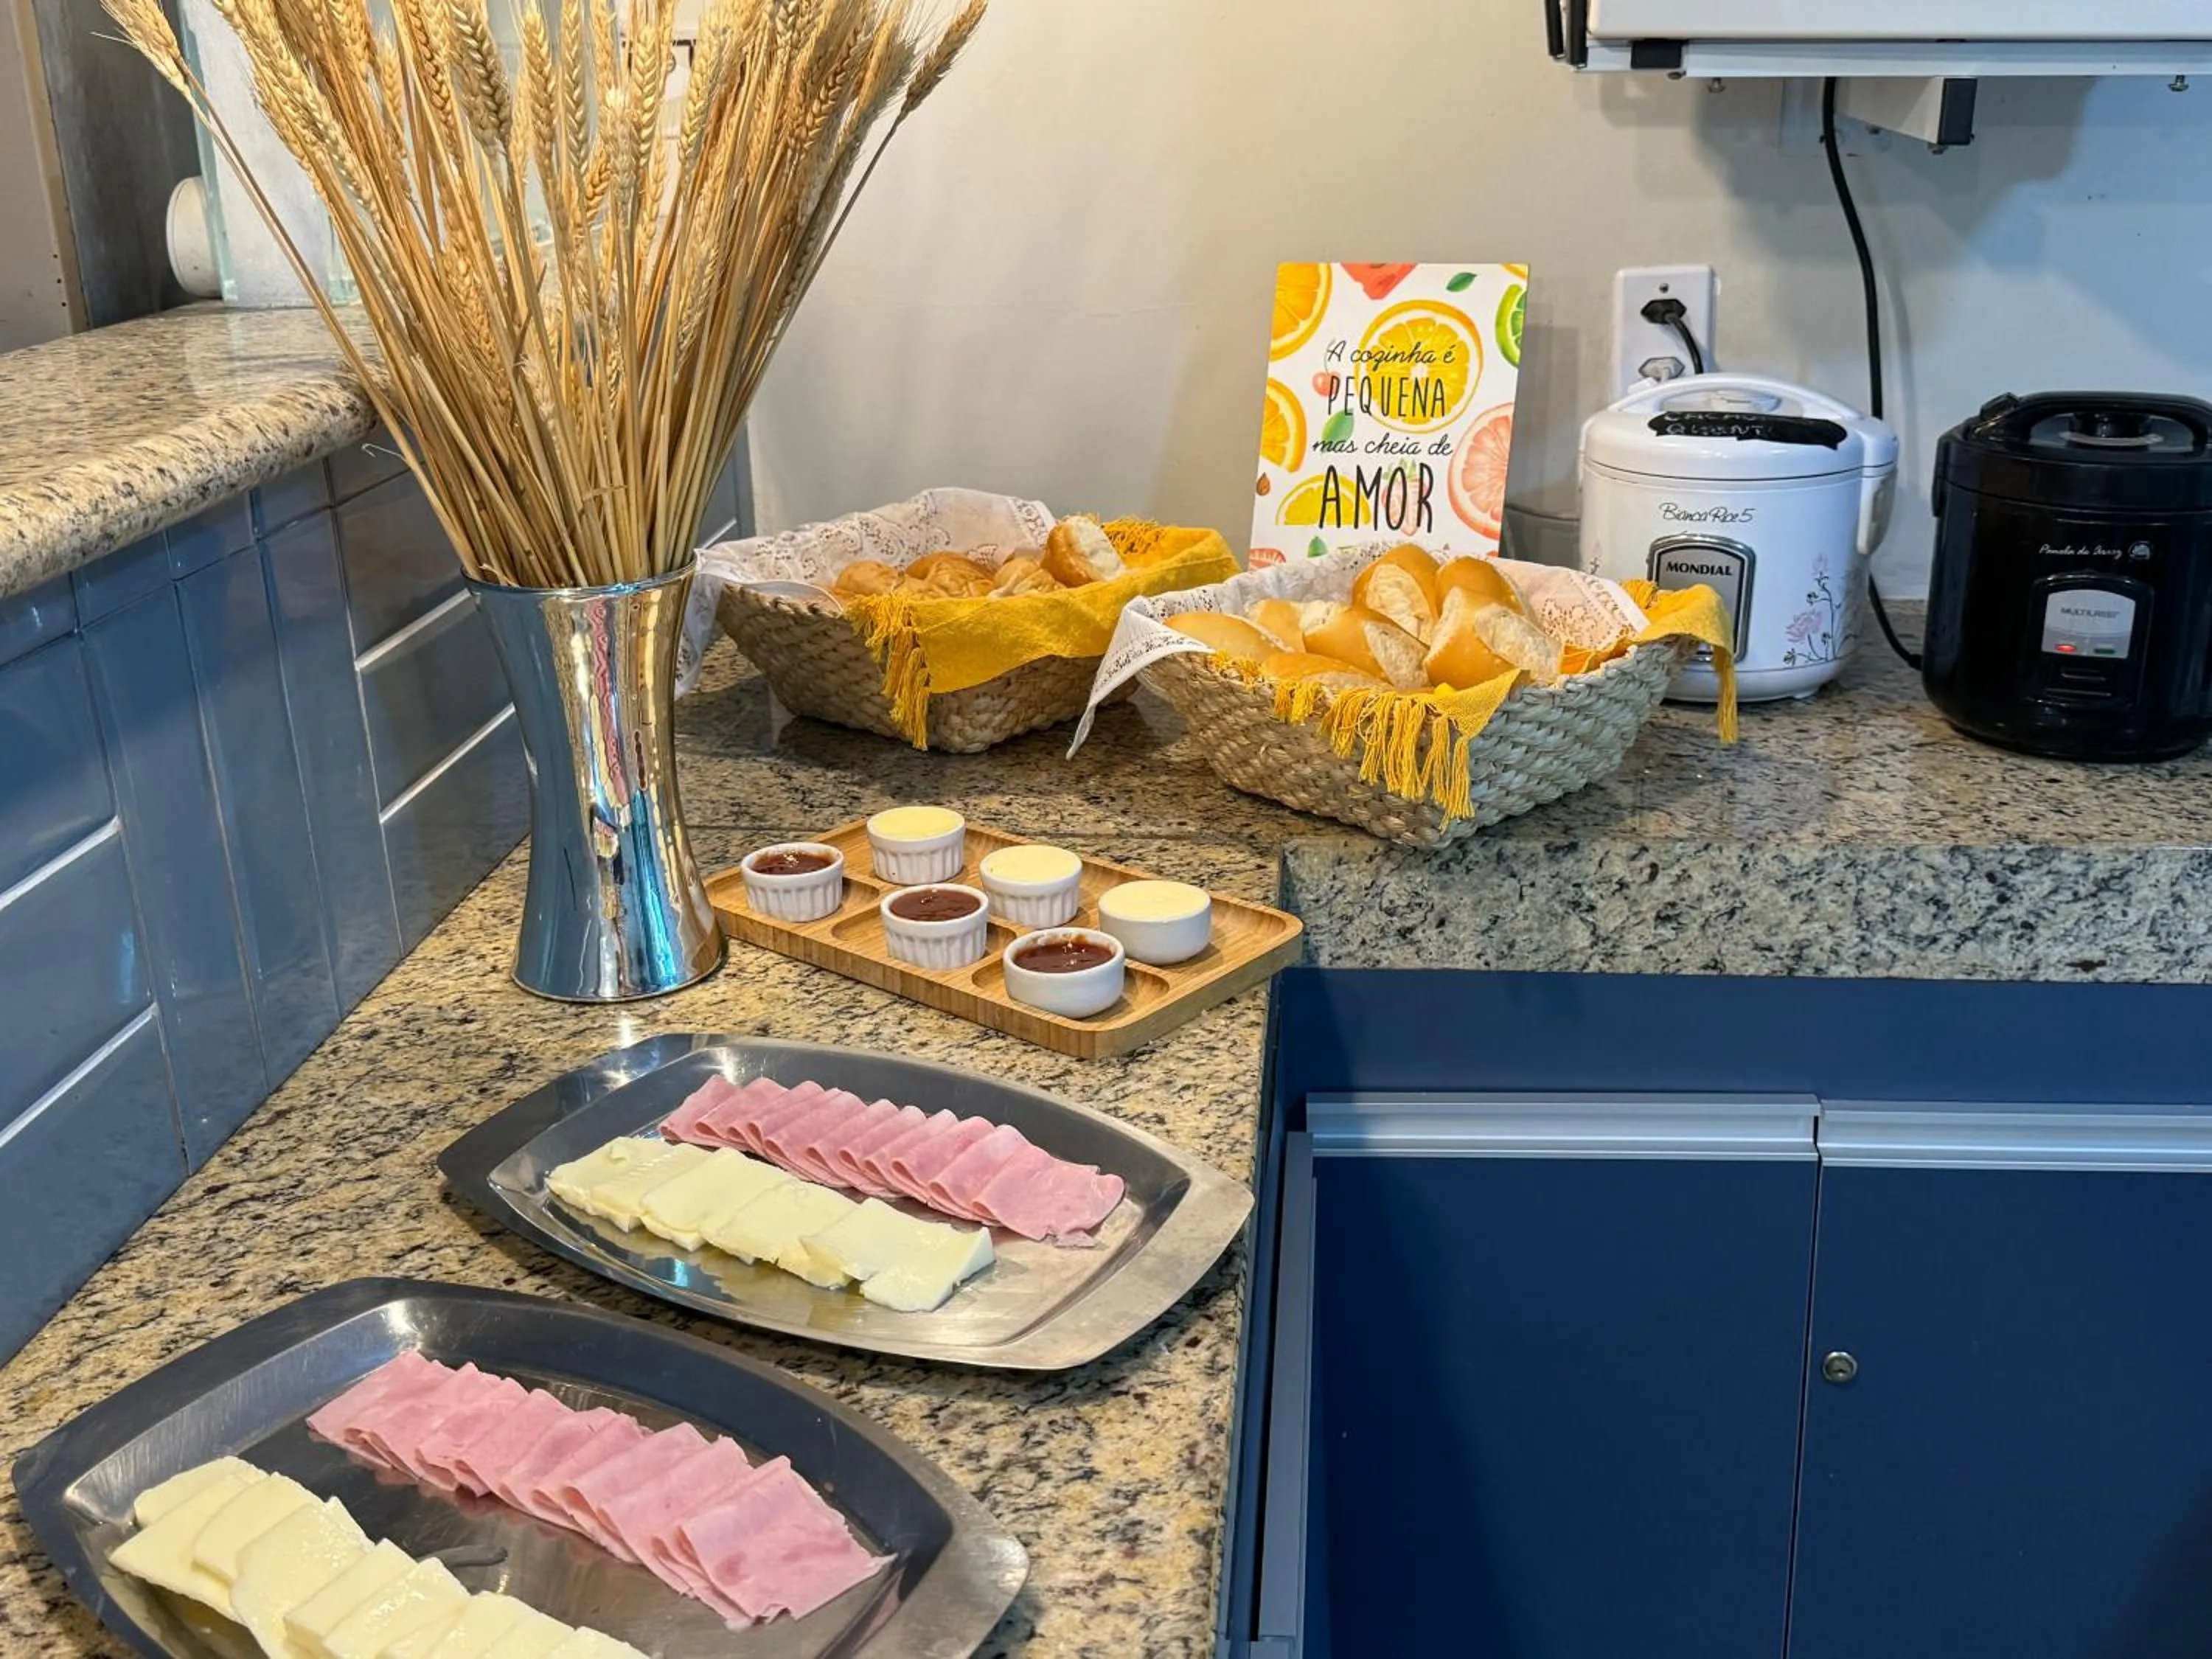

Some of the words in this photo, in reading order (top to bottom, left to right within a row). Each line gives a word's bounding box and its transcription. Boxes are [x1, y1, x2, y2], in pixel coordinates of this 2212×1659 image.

[1326, 340, 1346, 361] A
[1350, 341, 1437, 372] cozinha
[1443, 344, 1457, 364] é
[1327, 375, 1446, 417] PEQUENA
[1312, 438, 1358, 453] mas
[1364, 432, 1423, 454] cheia
[1427, 434, 1454, 456] de
[1318, 462, 1434, 534] AMOR
[1666, 561, 1732, 577] MONDIAL
